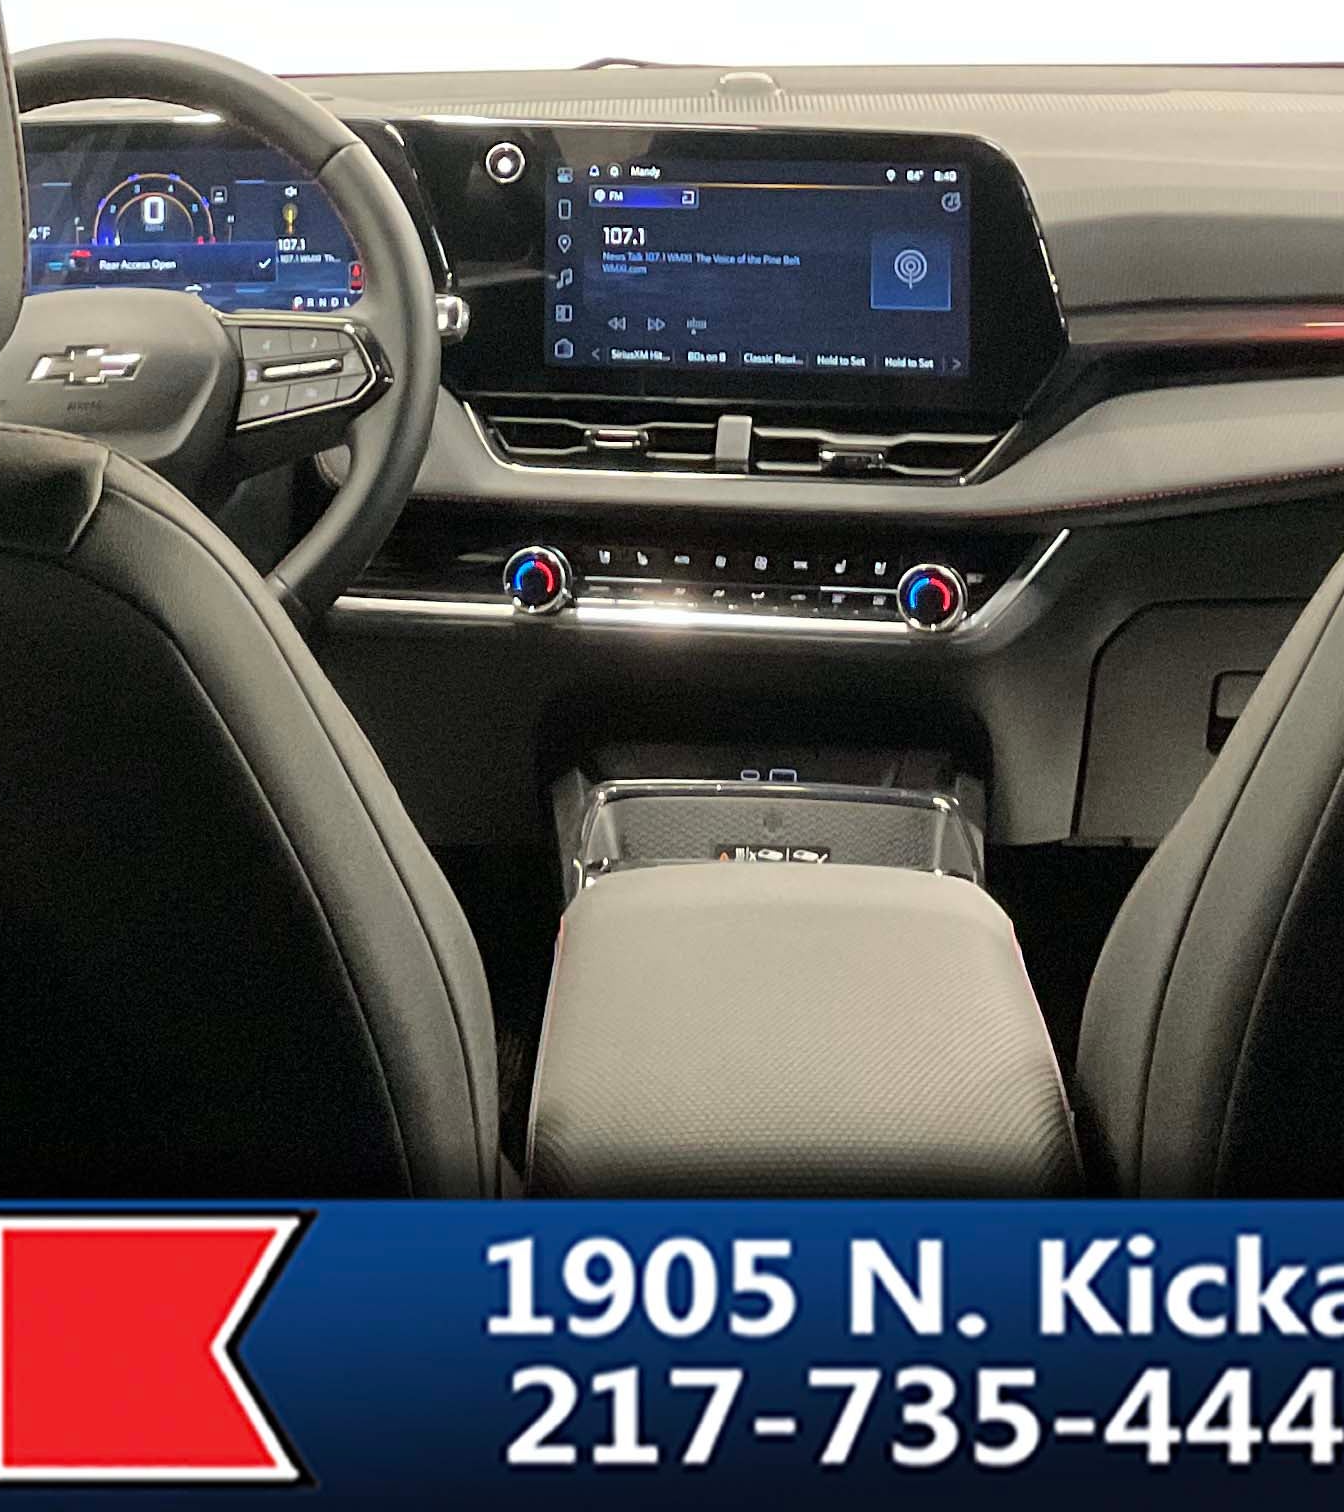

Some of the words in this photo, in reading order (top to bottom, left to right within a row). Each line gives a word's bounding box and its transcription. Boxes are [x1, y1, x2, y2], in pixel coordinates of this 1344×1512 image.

[630, 166, 661, 179] Mandy
[608, 191, 624, 202] FM
[143, 196, 165, 225] 0
[602, 227, 646, 246] 107.1
[278, 238, 306, 251] 107.1
[602, 251, 626, 262] News
[696, 253, 712, 264] The
[712, 253, 736, 265] Voice
[737, 253, 747, 264] of
[748, 254, 762, 265] the
[99, 260, 121, 270] Rear
[122, 259, 151, 270] Access
[152, 259, 177, 272] Open
[294, 296, 304, 307] P
[611, 348, 649, 361] SiriusXM
[706, 352, 718, 363] on
[743, 352, 774, 364] Classic
[817, 354, 839, 366] Hold
[839, 355, 850, 366] to
[850, 356, 866, 368] Set
[884, 356, 907, 368] Hold
[907, 357, 918, 368] to
[918, 358, 935, 369] Set
